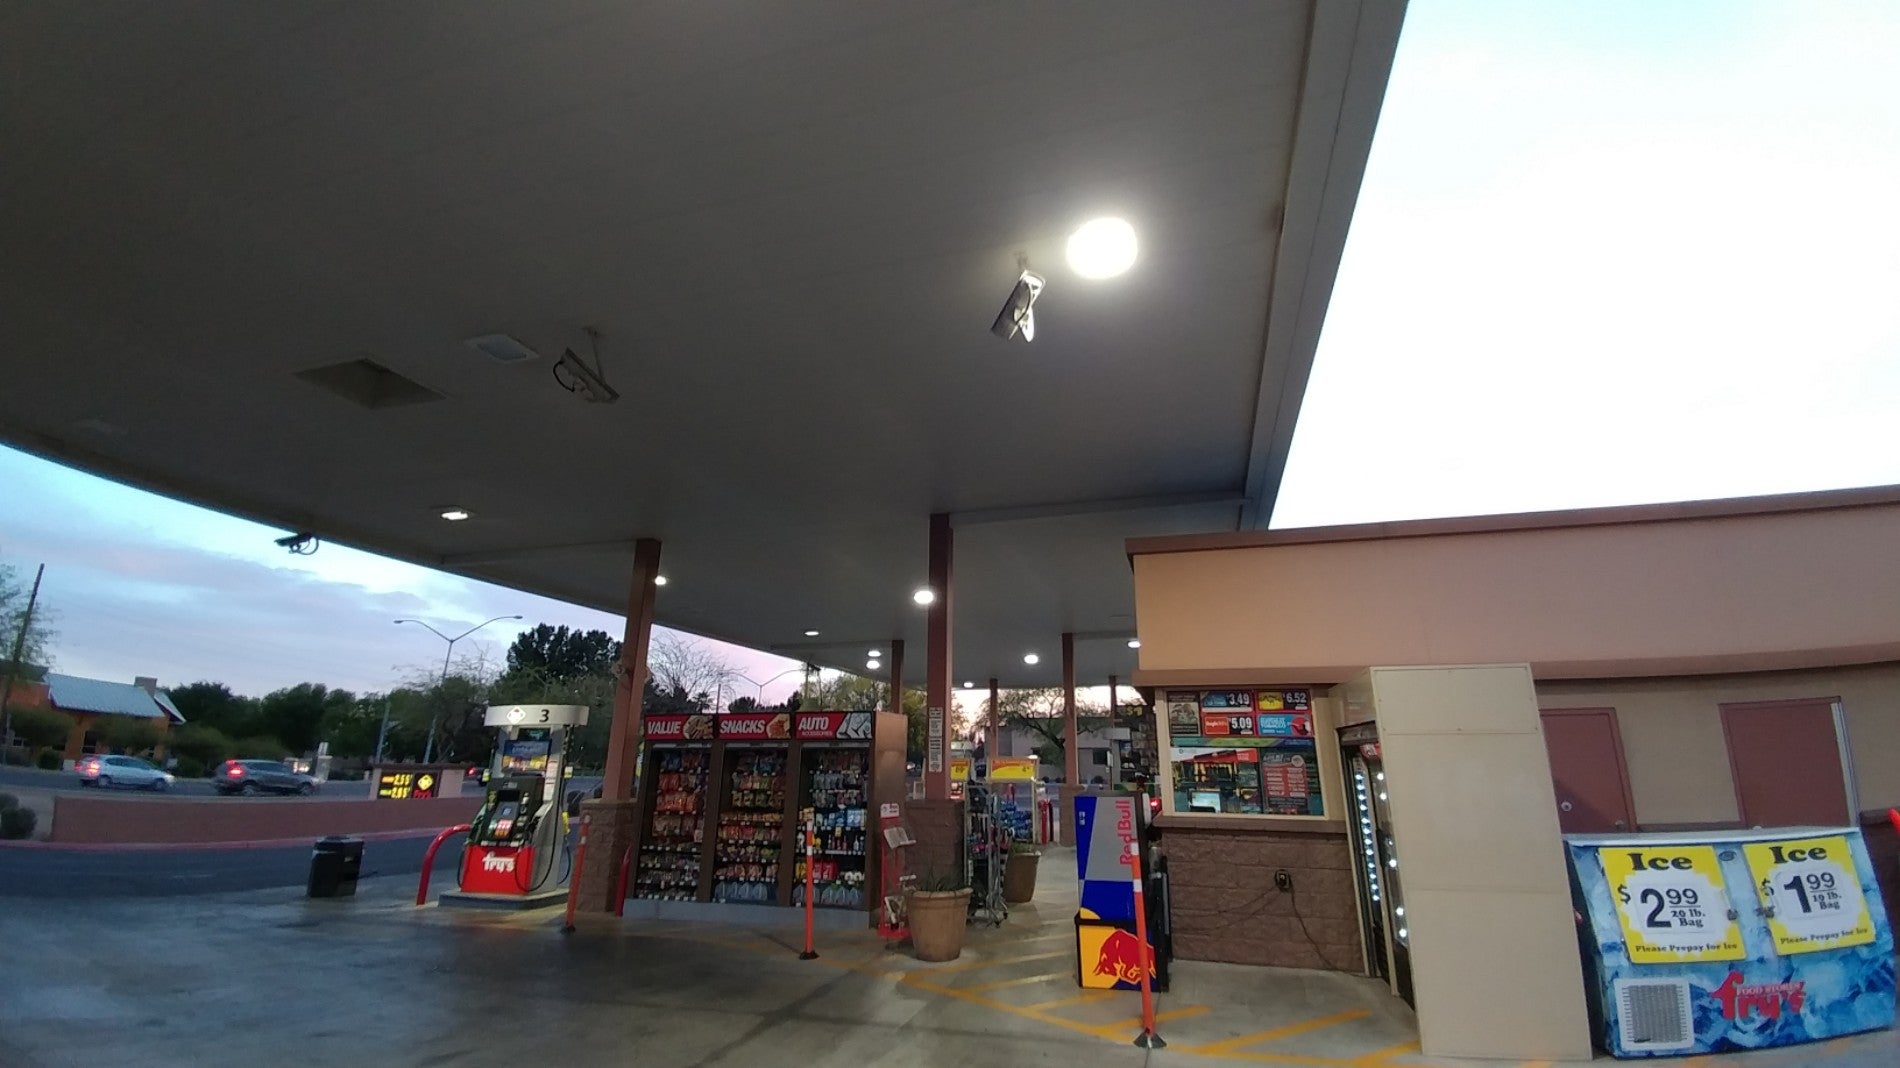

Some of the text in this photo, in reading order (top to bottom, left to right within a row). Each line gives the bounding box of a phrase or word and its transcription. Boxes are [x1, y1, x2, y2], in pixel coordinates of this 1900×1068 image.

[539, 709, 550, 722] 3
[647, 721, 681, 734] VALUE
[720, 720, 766, 734] SNACKS
[798, 716, 829, 731] AUTO
[1115, 800, 1132, 865] Red Bull
[1627, 852, 1693, 871] Ice
[1769, 846, 1828, 864] Ice
[1617, 884, 1631, 904] $
[1820, 901, 1841, 910] Bag
[1670, 909, 1706, 918] 20 lb.
[1679, 917, 1704, 928] Bag
[1635, 942, 1738, 953] Please Prepay for Ice
